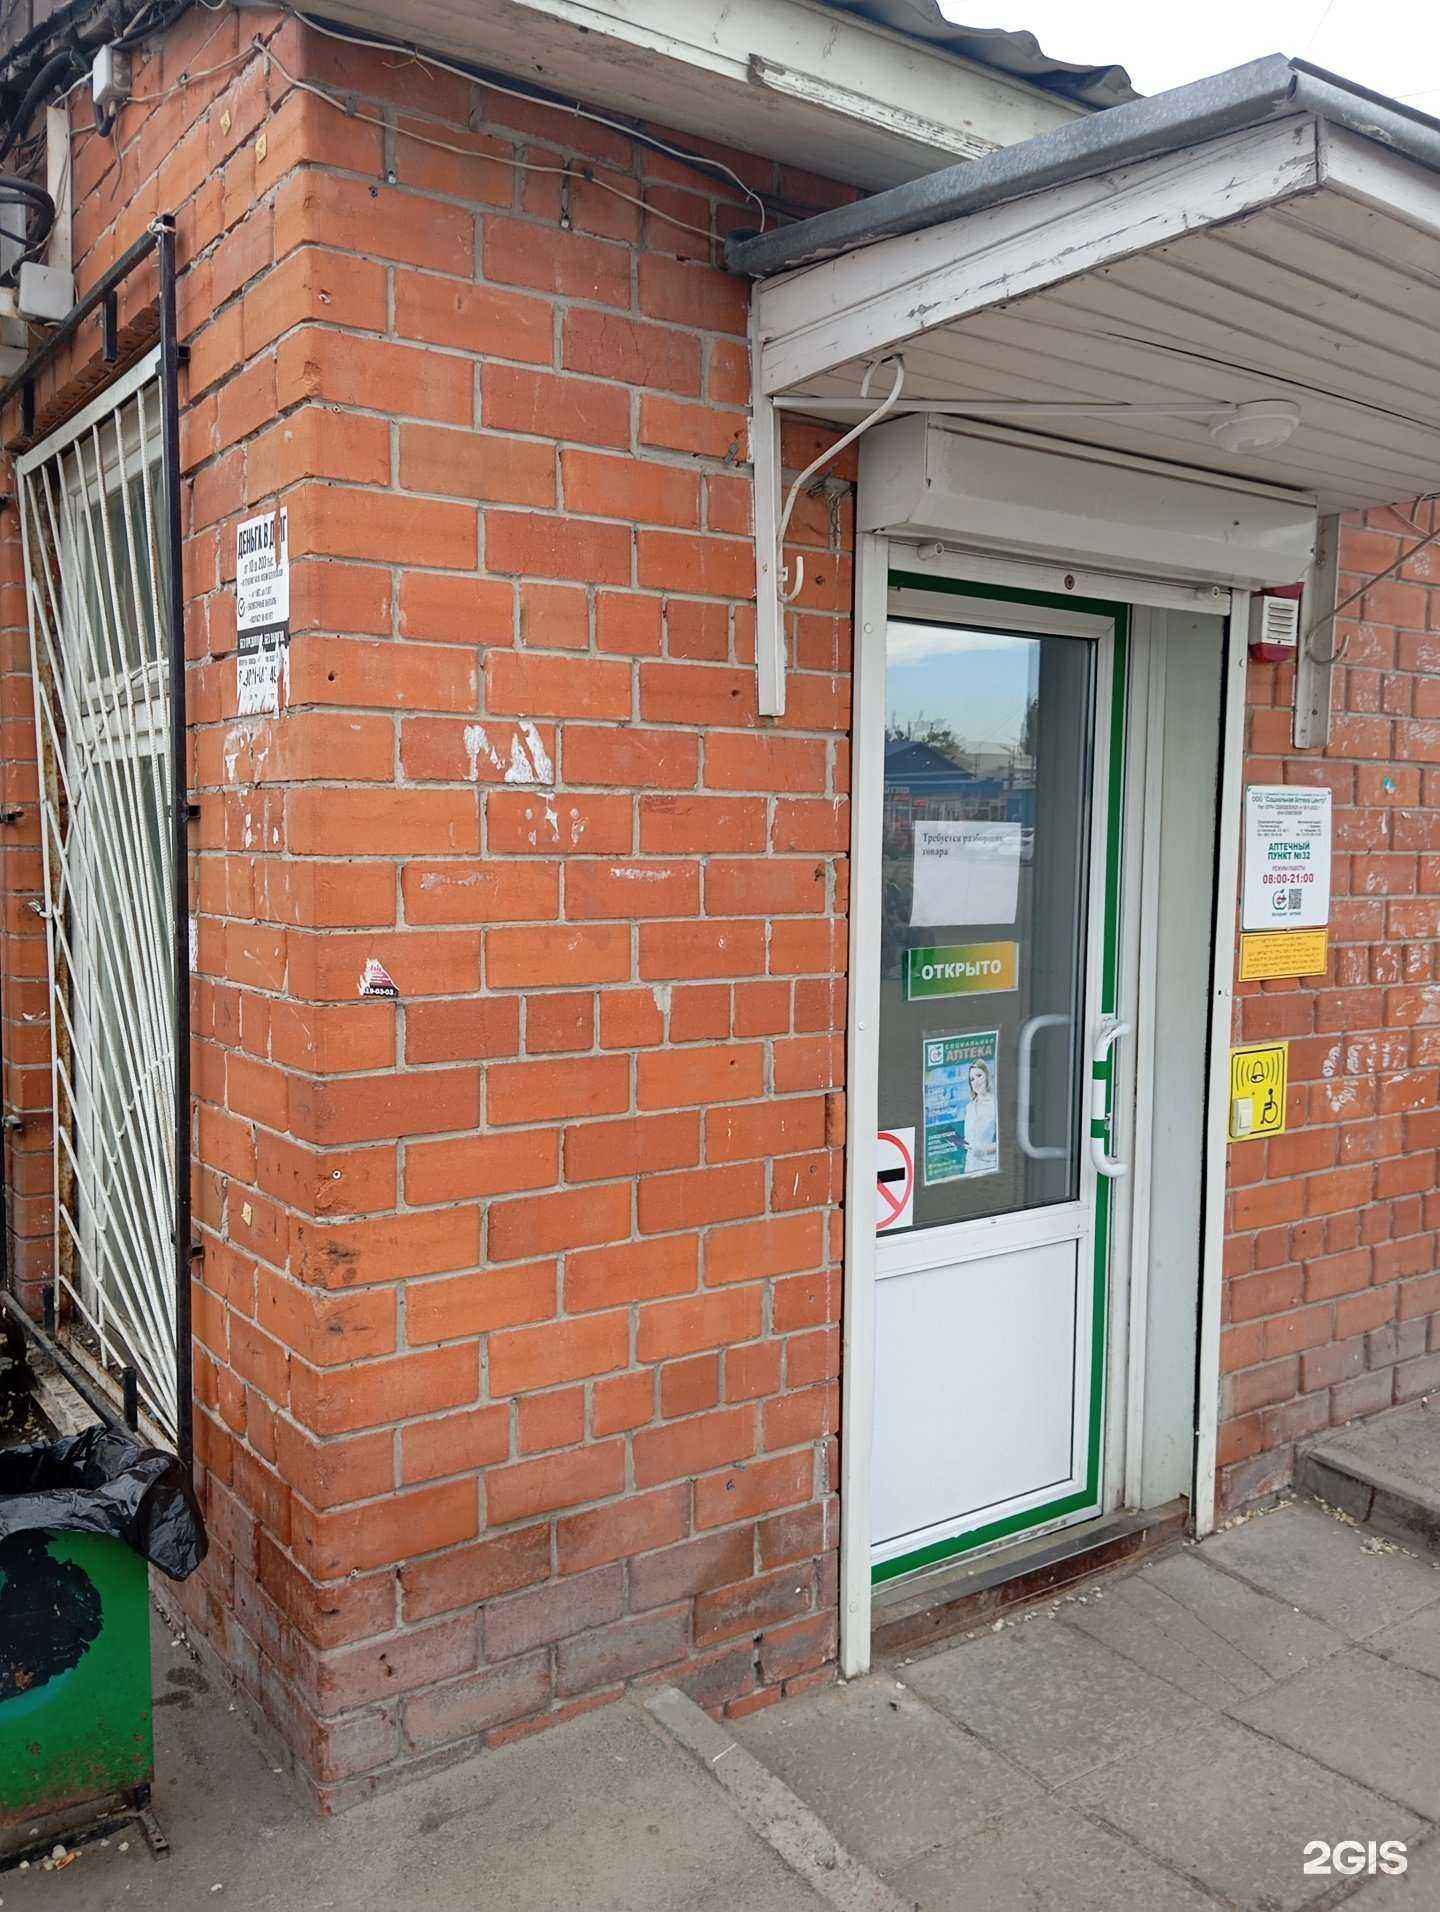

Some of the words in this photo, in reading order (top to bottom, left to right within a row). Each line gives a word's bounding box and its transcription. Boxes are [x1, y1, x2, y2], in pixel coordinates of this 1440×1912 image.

[263, 522, 269, 548] В
[922, 832, 961, 845] Требуется
[1268, 841, 1311, 851] АПТЕЧНЫЙ
[922, 848, 949, 858] товара
[1267, 851, 1292, 860] ПУНКТ
[1293, 851, 1311, 860] №32
[1262, 873, 1314, 884] 08:00-21:00
[921, 960, 1002, 980] ОТКРЫТО
[945, 1044, 993, 1062] АПТЕКА
